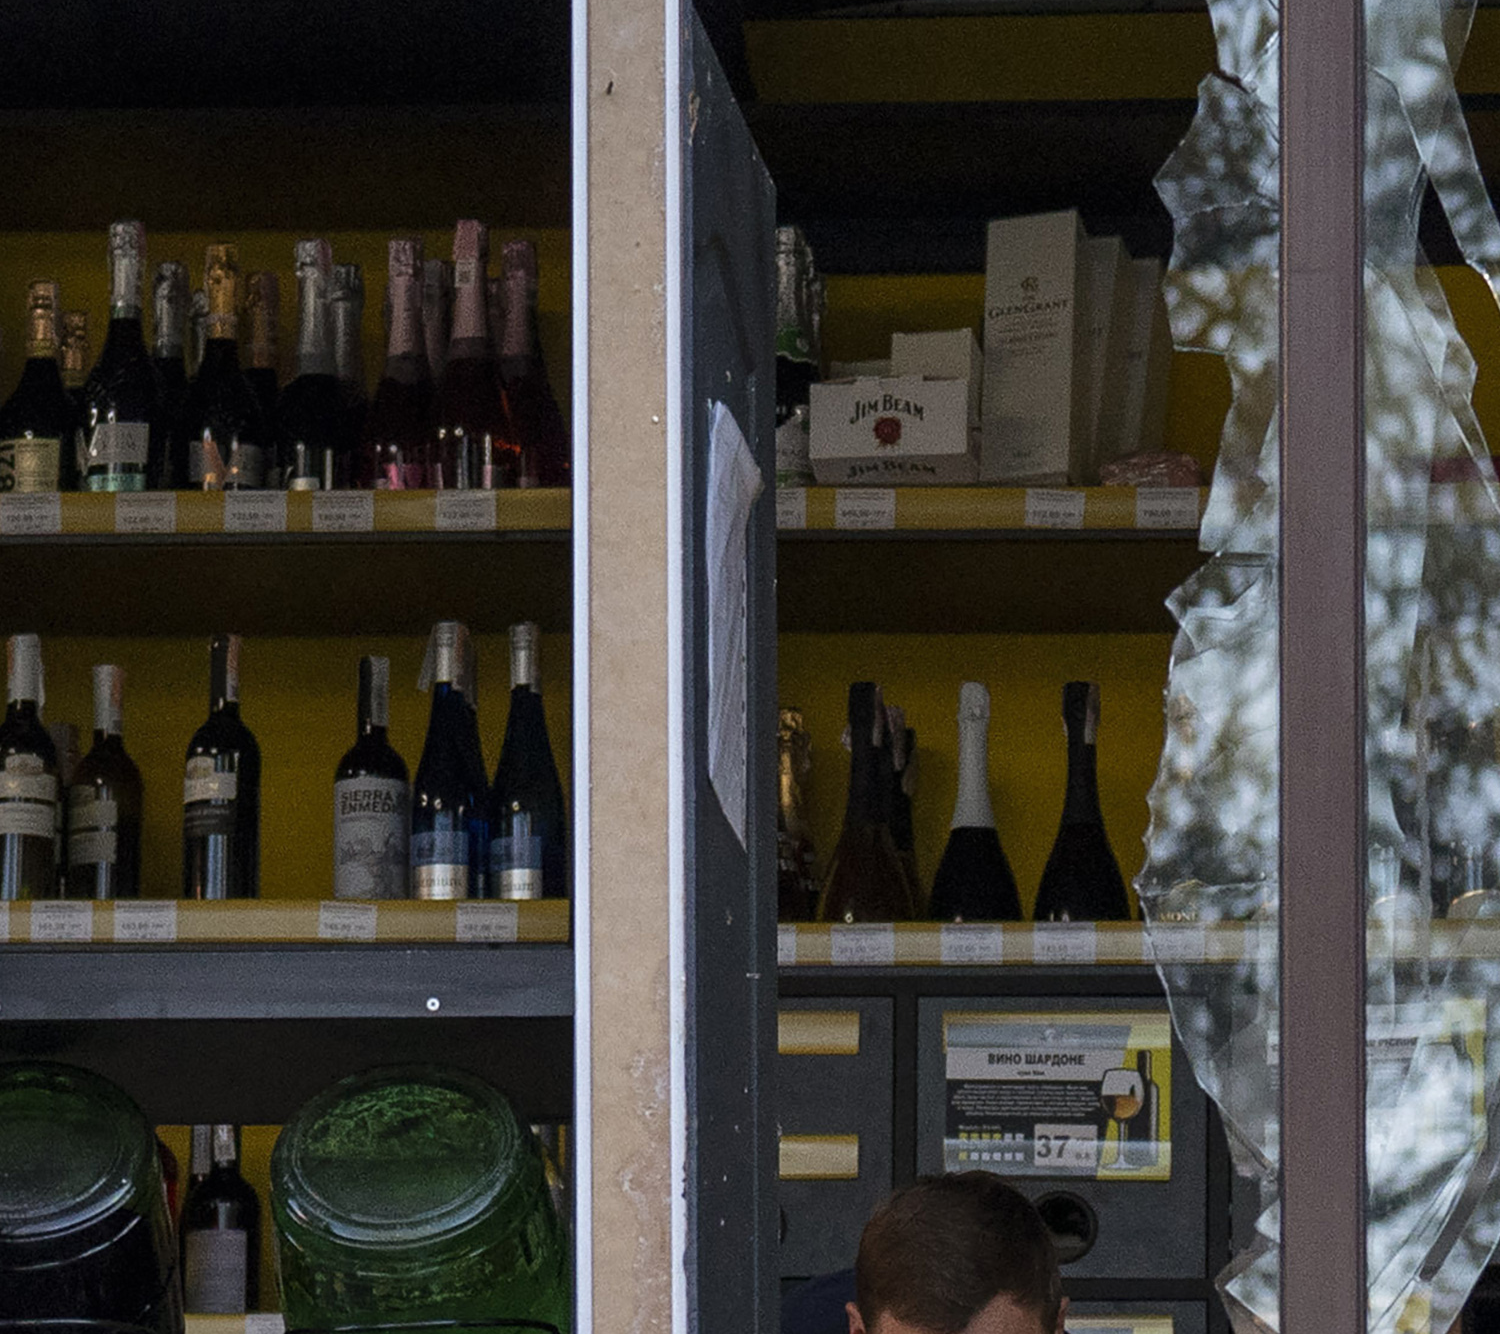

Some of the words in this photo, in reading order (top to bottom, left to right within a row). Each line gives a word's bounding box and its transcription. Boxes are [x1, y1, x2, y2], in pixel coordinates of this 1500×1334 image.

[988, 299, 1069, 319] GLENGRANT
[850, 399, 879, 424] JIM
[883, 394, 925, 422] BEAM
[341, 789, 394, 802] SIERRA
[988, 1053, 1021, 1065] ВИНО
[1025, 1053, 1085, 1067] ШАРДОНЕ
[1037, 1135, 1070, 1159] 37
